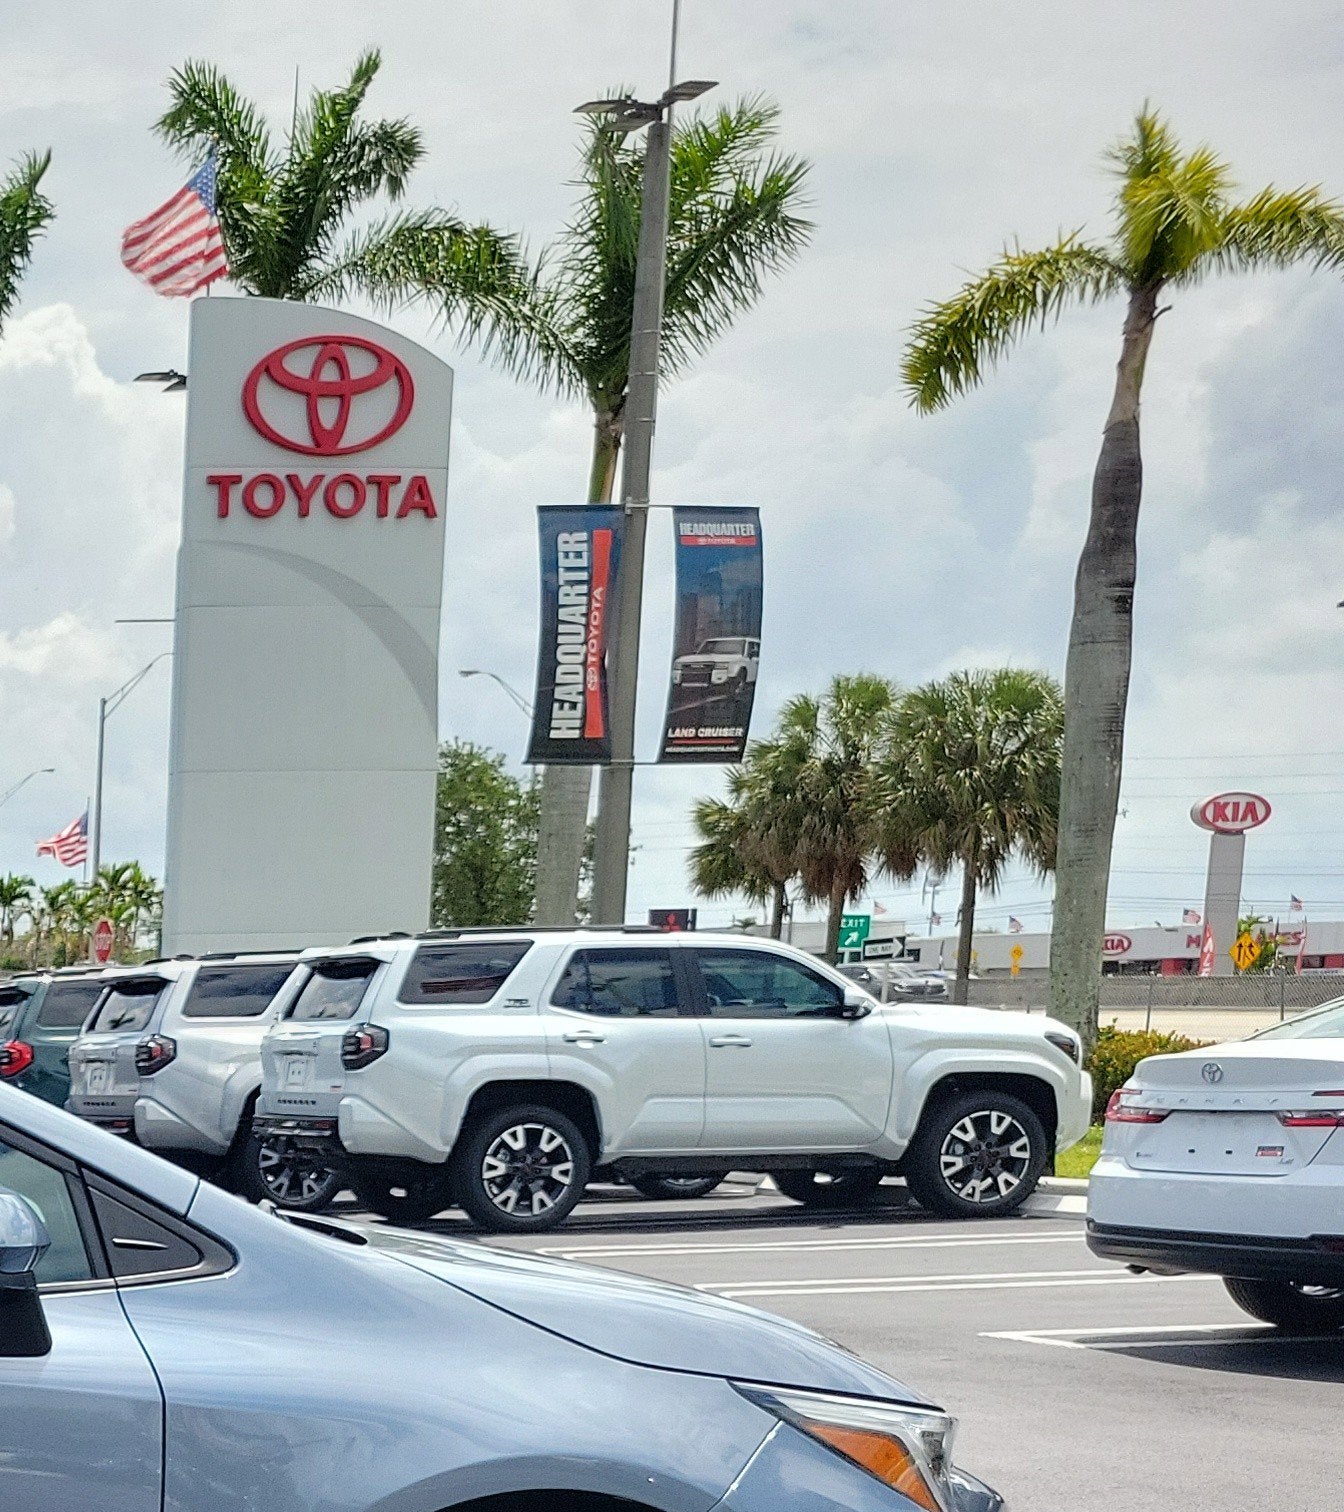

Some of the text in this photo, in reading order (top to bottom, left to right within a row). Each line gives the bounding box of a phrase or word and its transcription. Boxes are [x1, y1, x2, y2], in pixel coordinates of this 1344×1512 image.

[206, 473, 438, 518] TOYOTA
[680, 522, 756, 537] HEADQUARTER
[549, 530, 590, 740] HEADQUARTER
[587, 586, 605, 665] TOYOTA
[667, 726, 744, 738] LAND CRUISER
[1212, 801, 1260, 823] KIA
[841, 918, 866, 928] EXIT
